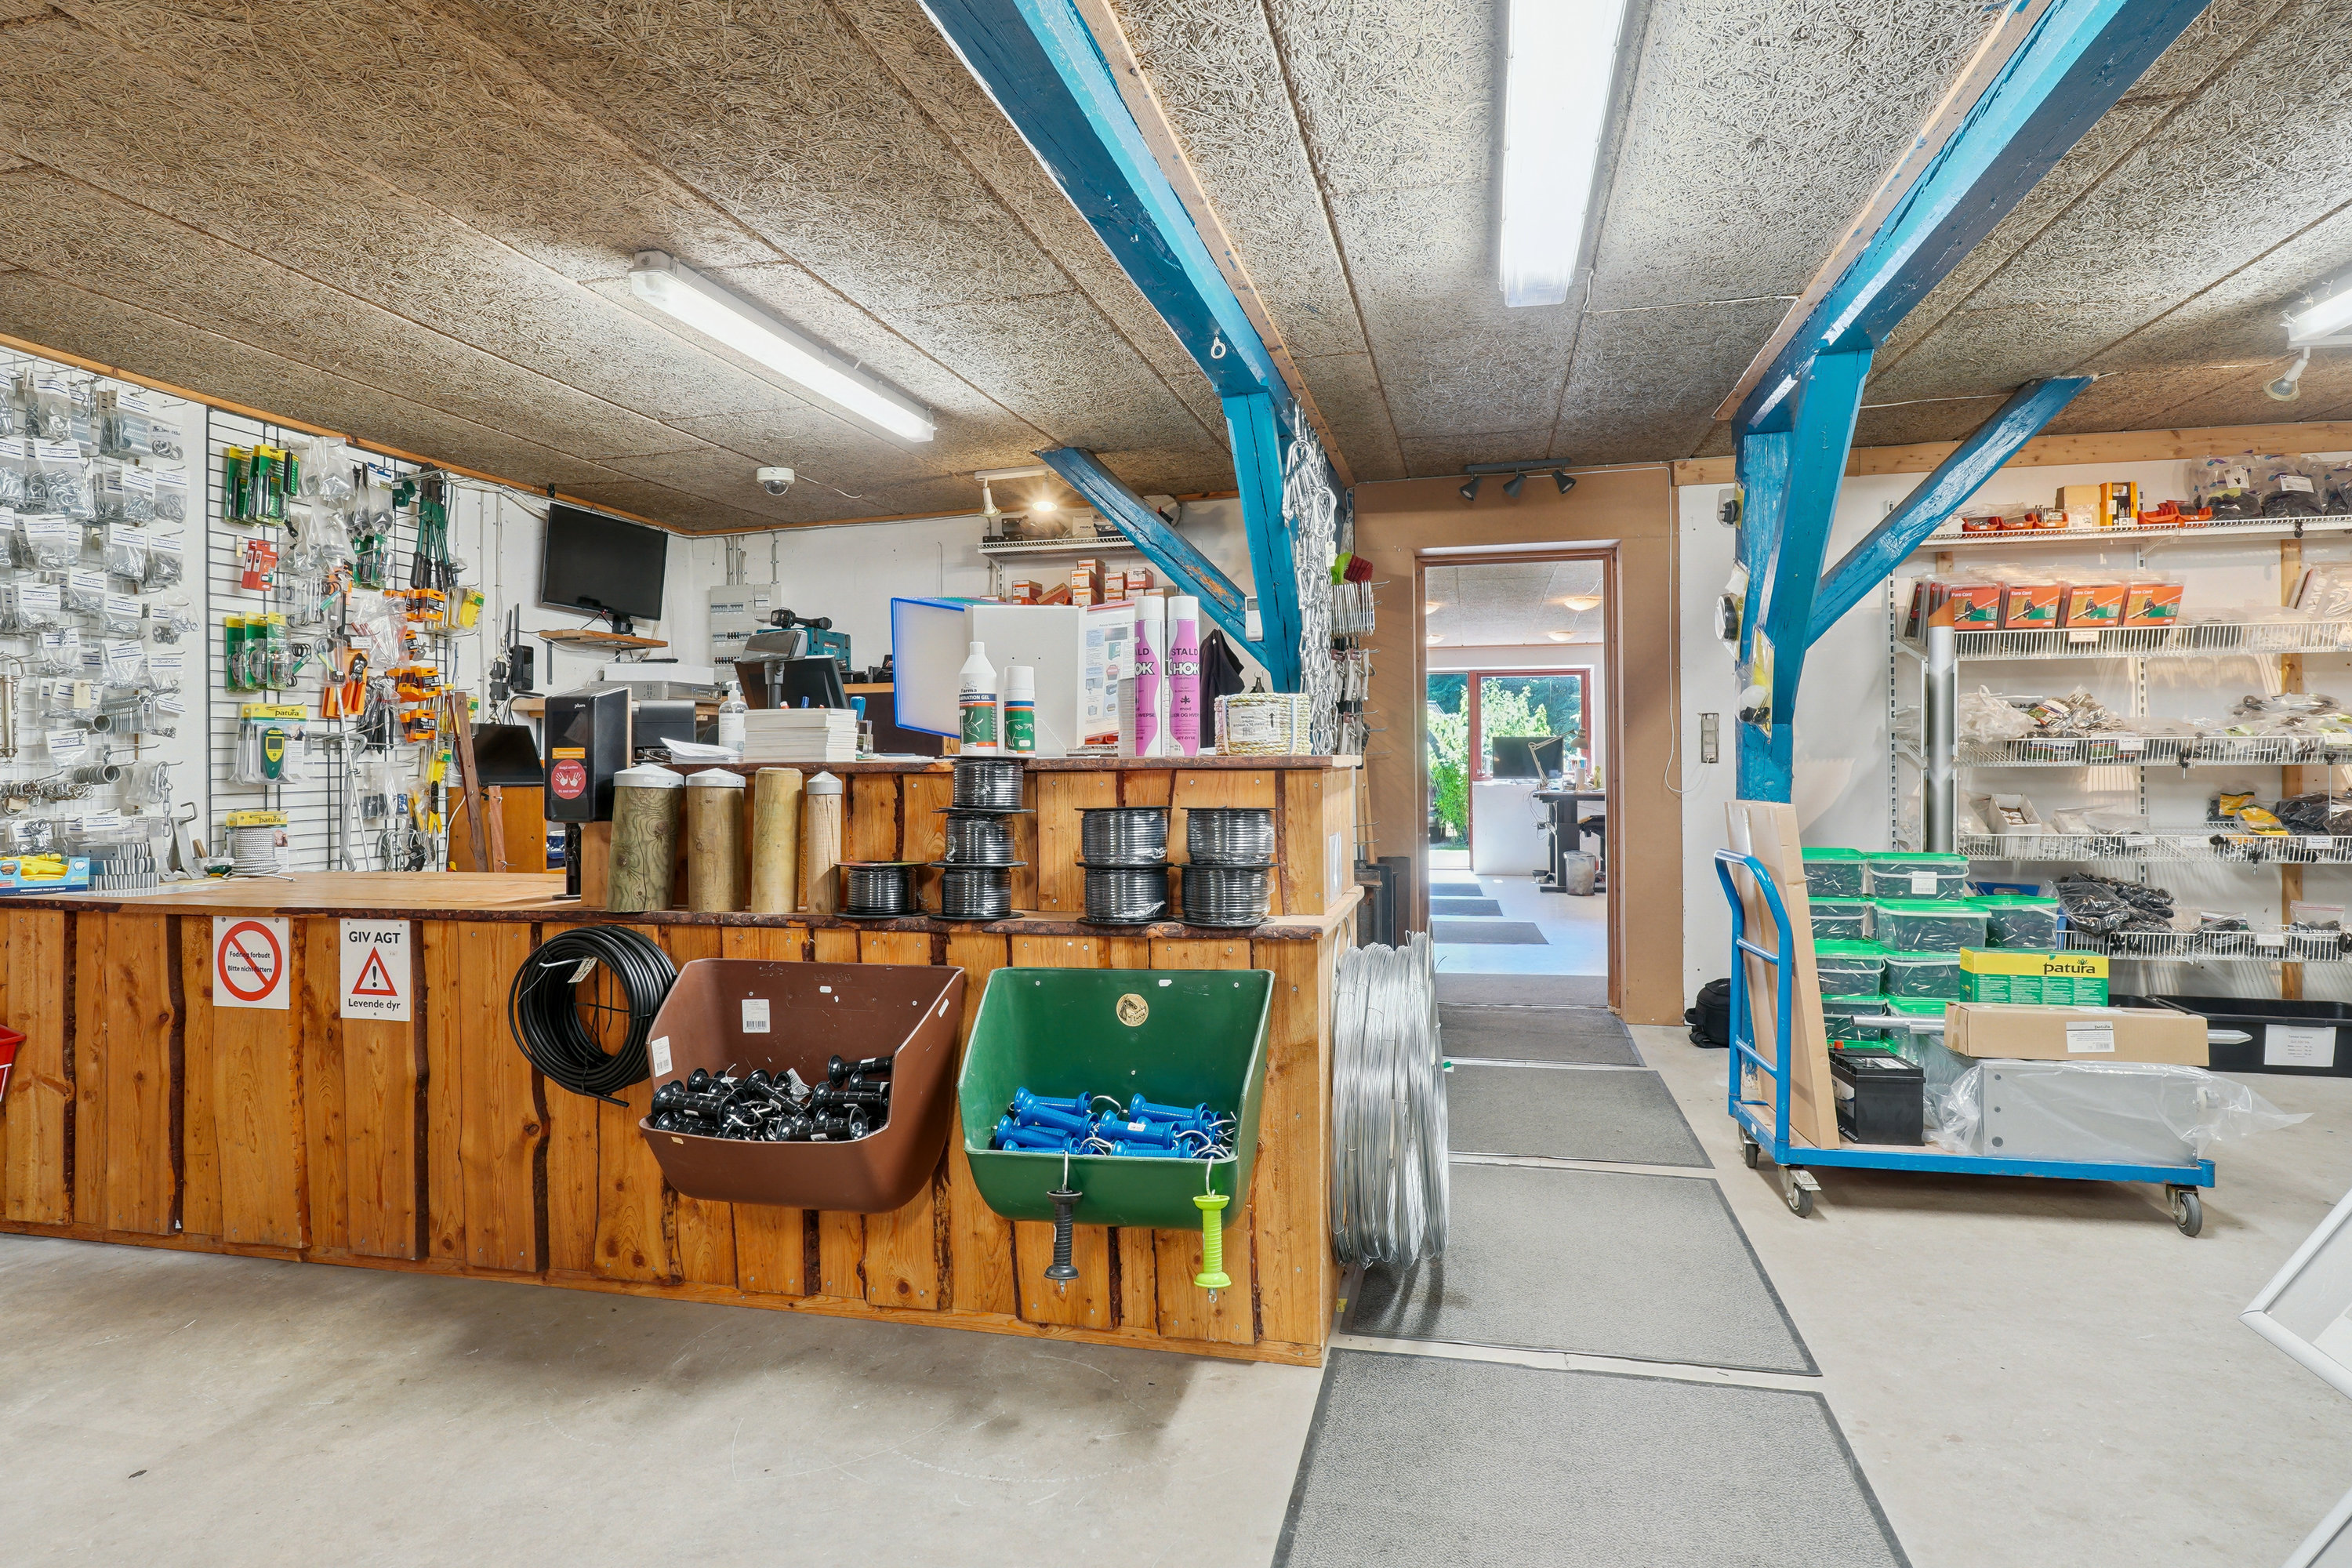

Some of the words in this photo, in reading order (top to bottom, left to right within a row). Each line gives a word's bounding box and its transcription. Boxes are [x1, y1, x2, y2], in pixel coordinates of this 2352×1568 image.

[349, 931, 371, 942] GIV
[374, 932, 401, 944] AGT
[2043, 962, 2096, 975] patura
[348, 998, 384, 1008] Levende
[387, 1000, 401, 1011] dyr
